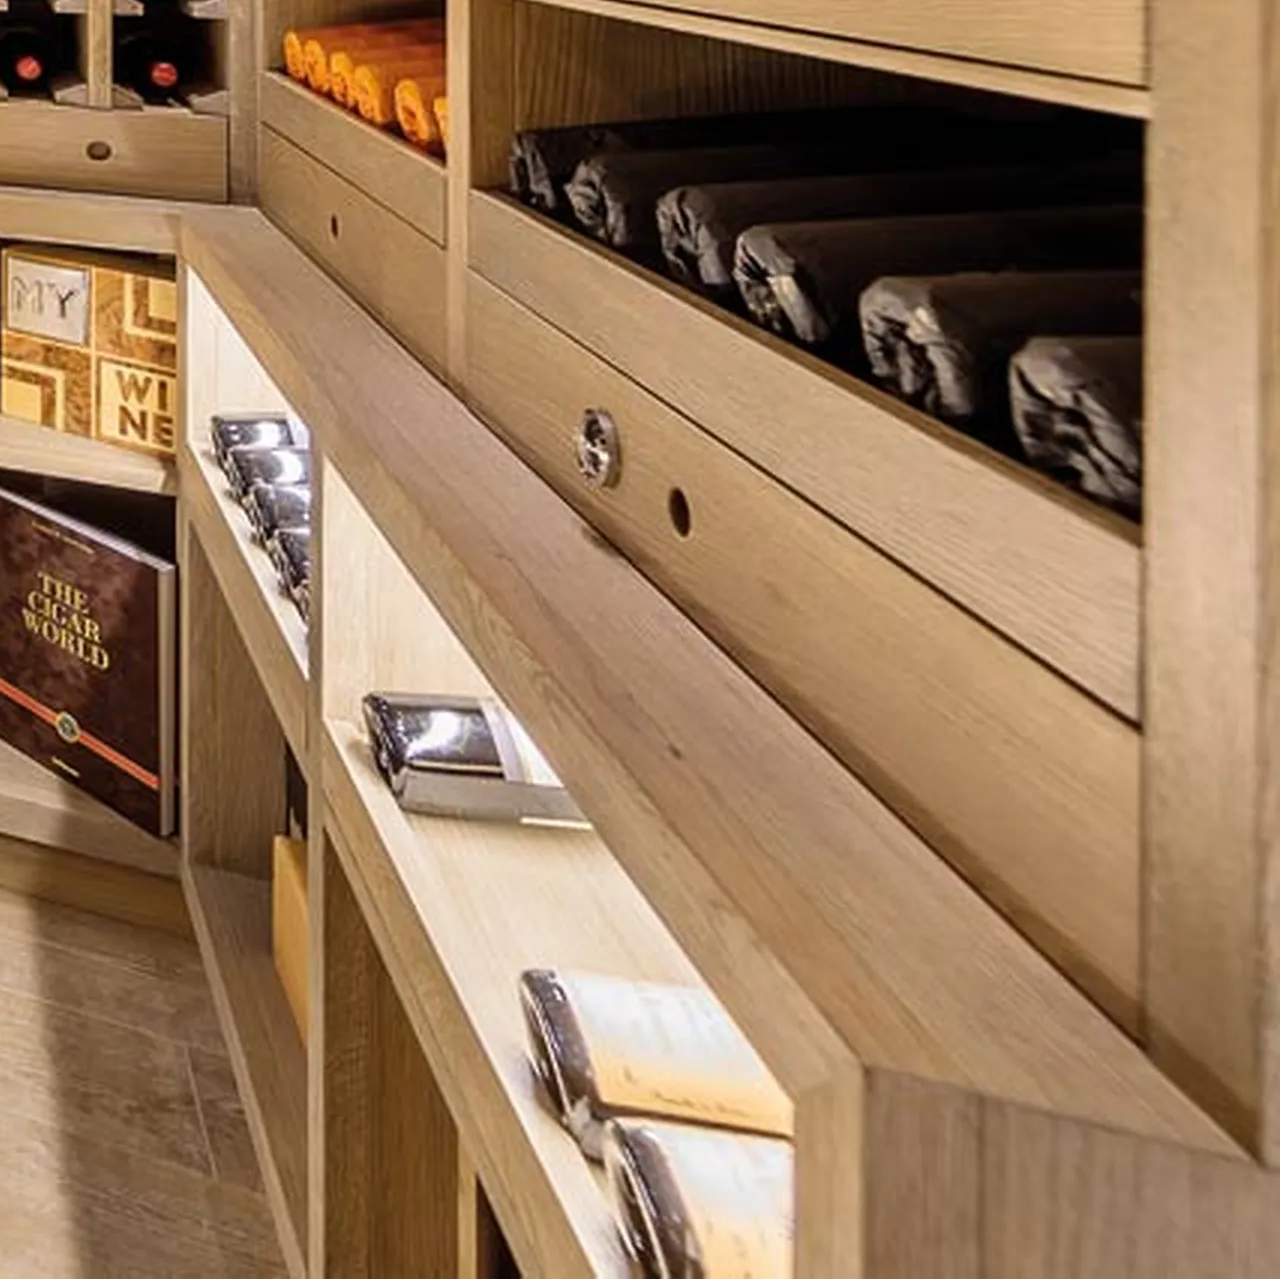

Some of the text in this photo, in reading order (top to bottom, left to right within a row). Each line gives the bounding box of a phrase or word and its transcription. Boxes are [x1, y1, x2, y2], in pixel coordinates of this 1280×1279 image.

[12, 275, 80, 319] MY
[27, 590, 101, 643] CIGAR
[37, 571, 90, 614] THE
[22, 607, 110, 670] WORLD
